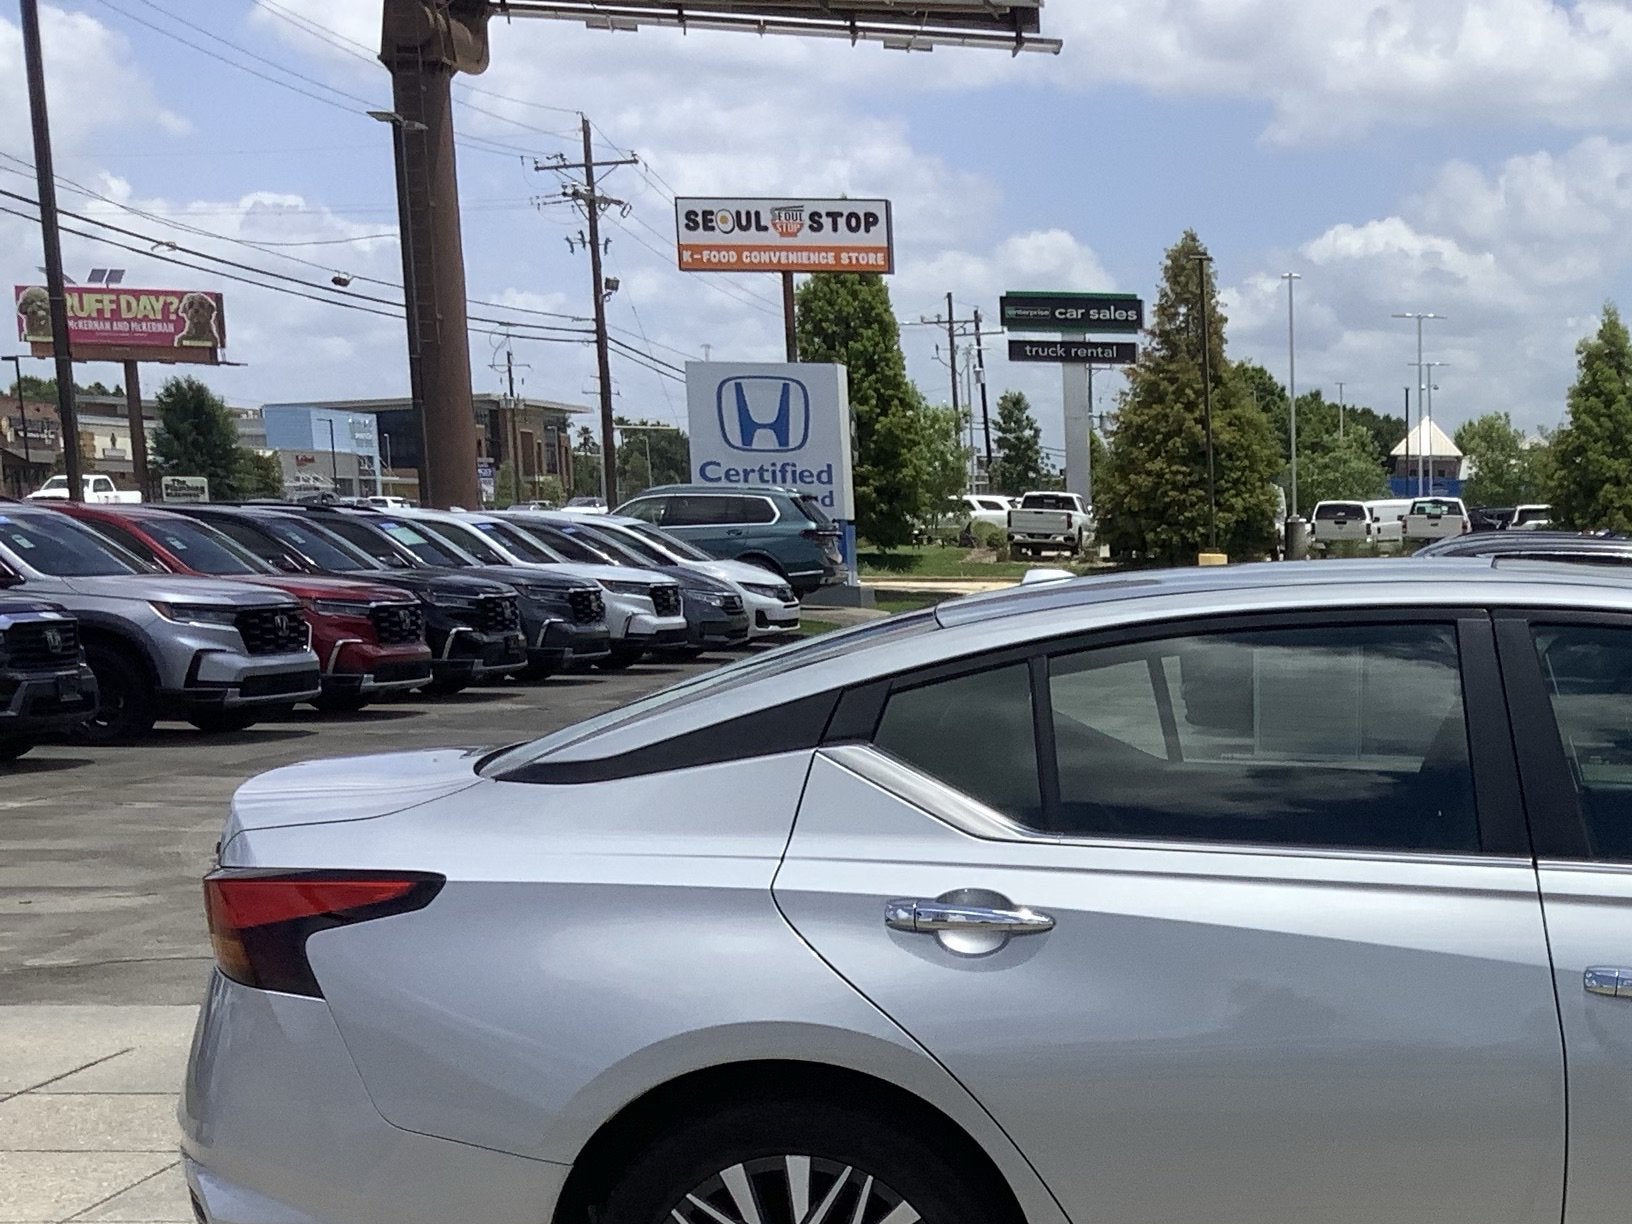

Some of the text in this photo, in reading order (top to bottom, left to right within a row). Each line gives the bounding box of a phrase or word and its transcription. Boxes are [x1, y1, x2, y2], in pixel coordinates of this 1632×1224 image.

[684, 208, 880, 235] SEOUL STOP
[681, 250, 885, 265] K-FOOD CONVENIENCE STORE
[119, 294, 179, 320] DAY?
[1055, 307, 1085, 319] car
[1089, 305, 1137, 321] sales
[112, 321, 130, 332] AND
[1025, 344, 1117, 358] truck rental
[699, 460, 834, 485] Certified
